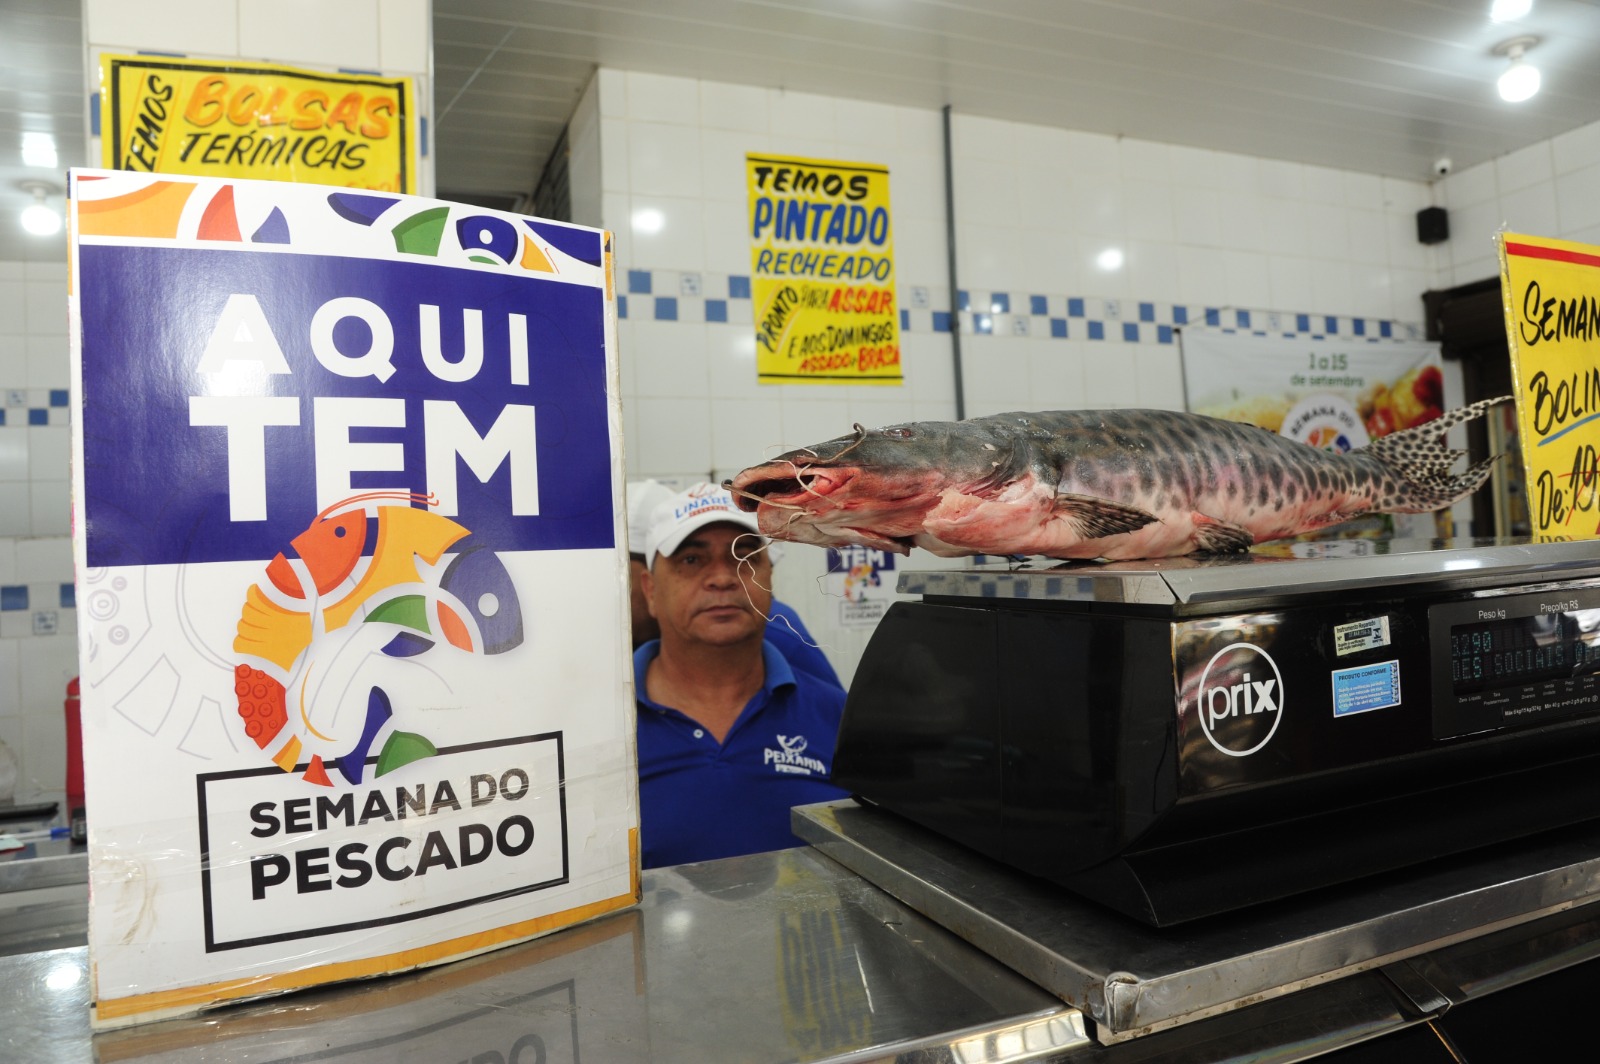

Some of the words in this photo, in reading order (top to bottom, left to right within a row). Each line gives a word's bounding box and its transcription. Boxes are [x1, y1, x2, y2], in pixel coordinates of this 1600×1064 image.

[183, 74, 396, 140] BOLSAS
[124, 74, 174, 172] TEMOS
[754, 166, 869, 200] TEMOS
[753, 197, 889, 246] PINTADO
[756, 250, 891, 281] RECHEADO
[828, 287, 893, 317] ASSAR
[756, 286, 798, 354] PRONTO
[195, 293, 531, 387] AQUI
[826, 321, 893, 352] DOMINGOS
[1331, 354, 1348, 371] 15
[1290, 374, 1305, 386] de
[1309, 374, 1365, 388] setembro
[1290, 406, 1337, 435] SEMANA
[188, 396, 540, 523] TEM
[841, 547, 885, 570] TEM
[1478, 610, 1496, 619] Peso
[1497, 608, 1506, 619] kg
[1540, 601, 1568, 613] Preço/kg
[1569, 599, 1579, 610] R$
[1338, 672, 1361, 681] PRODUTO
[1361, 667, 1387, 677] CONFORME
[1494, 645, 1564, 675] SOCIAIS
[1207, 672, 1278, 731] prix
[250, 780, 462, 838] SEMANA
[469, 768, 530, 808] DO
[250, 814, 535, 901] PESCADO
